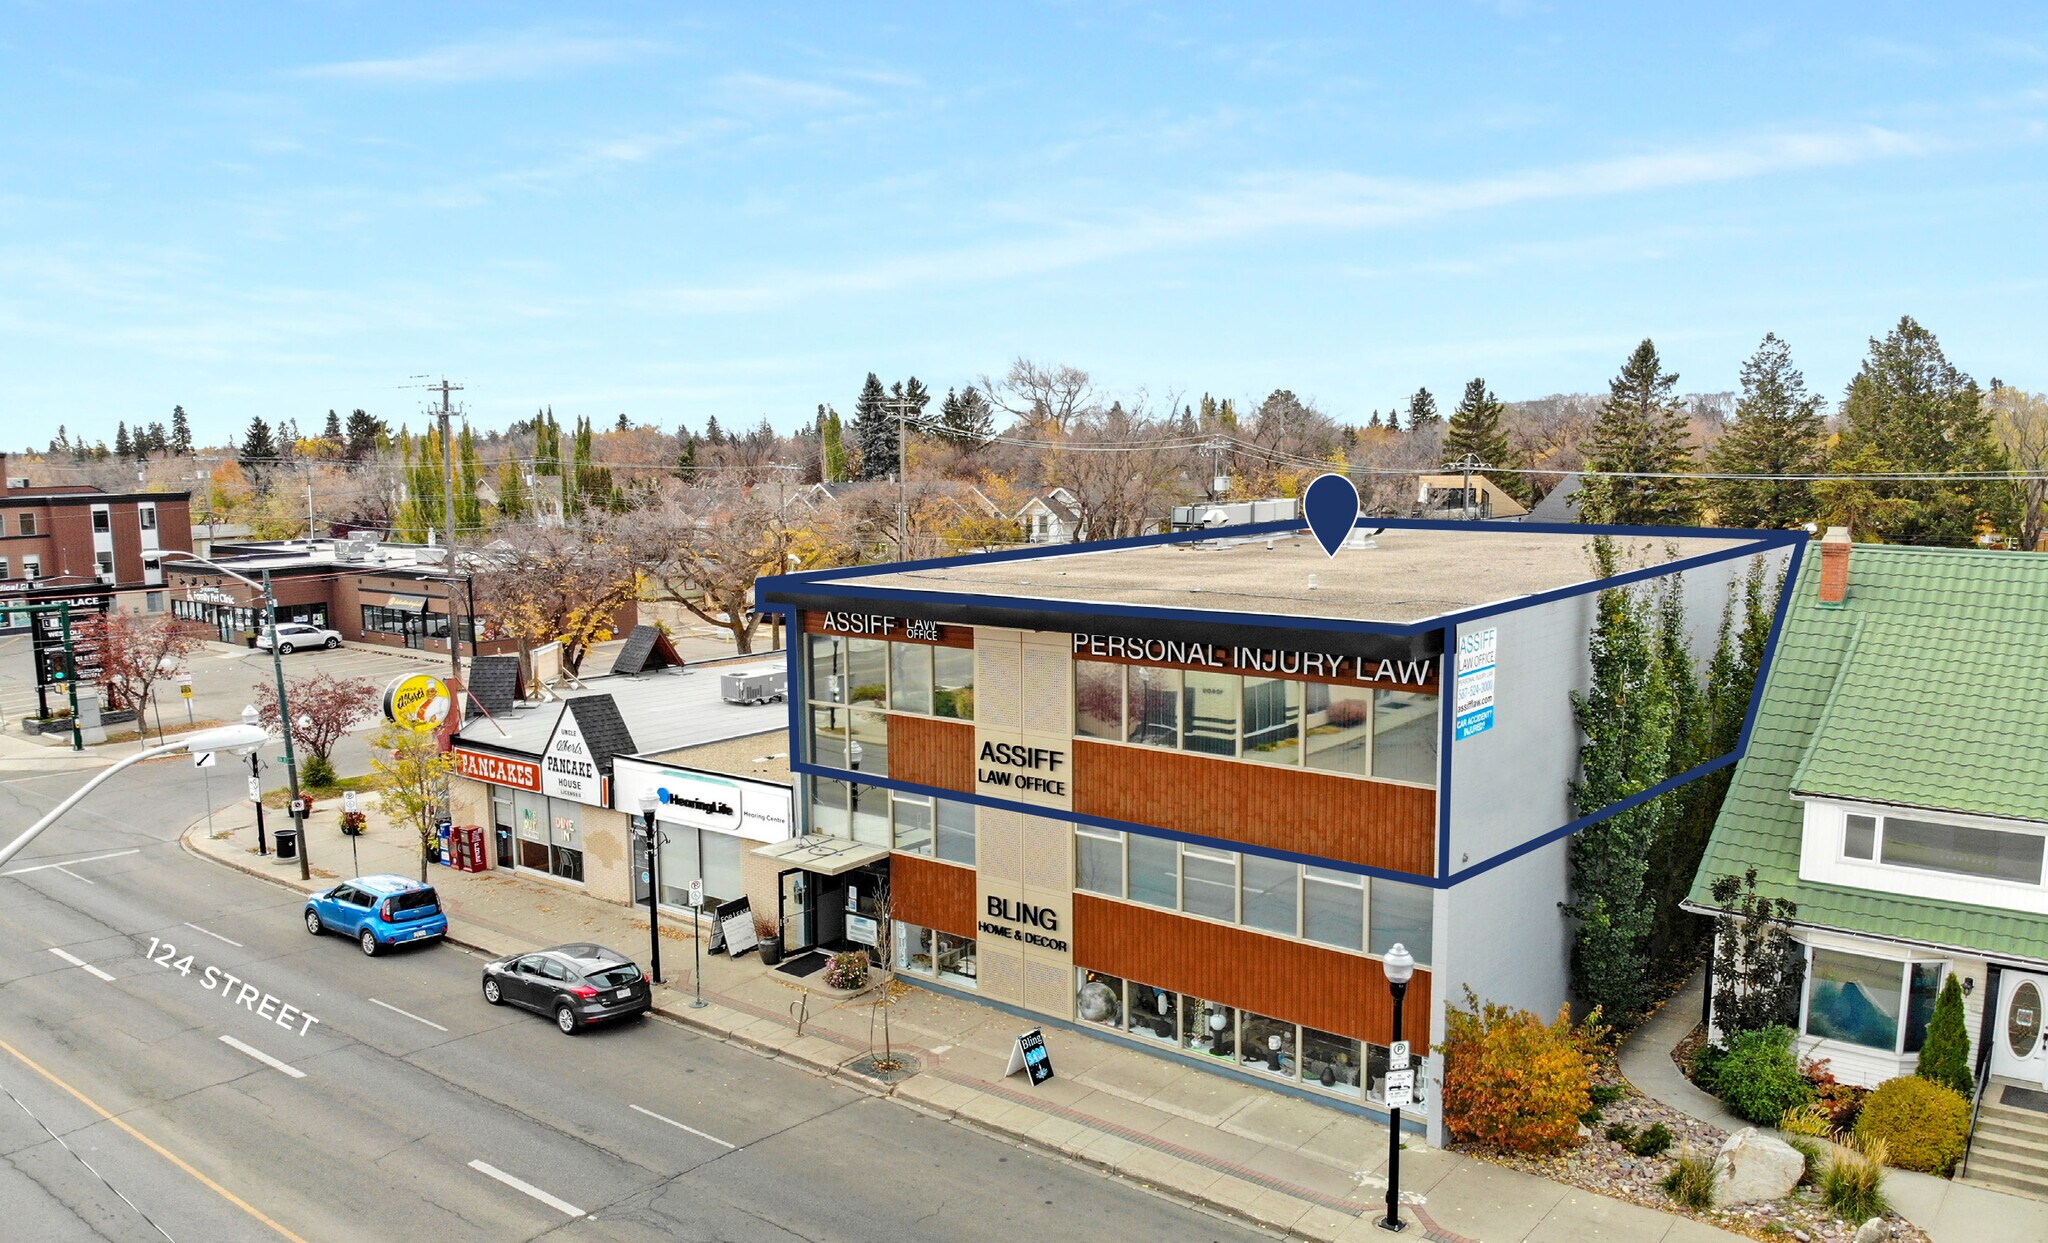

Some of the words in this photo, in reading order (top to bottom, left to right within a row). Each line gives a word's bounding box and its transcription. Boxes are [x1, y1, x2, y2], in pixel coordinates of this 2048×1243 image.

[823, 611, 895, 636] ASSIFF
[906, 618, 936, 631] LAW
[906, 629, 938, 641] OFFICE
[1460, 629, 1495, 655] ASSIFF
[1073, 633, 1223, 668] PERSONAL
[1233, 646, 1344, 678] INJURY
[1356, 656, 1430, 686] LAW
[1459, 655, 1474, 672] LAW
[1474, 650, 1495, 667] OFFICE
[561, 729, 577, 737] UNCLE
[547, 756, 593, 779] PANCAKE
[980, 741, 1064, 772] ASSIFF
[461, 753, 534, 787] PANCAKES
[558, 778, 582, 790] HOUSE
[978, 768, 1012, 787] LAW
[1014, 775, 1066, 796] OFFICE
[669, 793, 734, 816] HearingLife
[555, 817, 575, 832] DINE
[743, 811, 766, 822] Hearing
[766, 814, 786, 824] Centre
[987, 895, 1057, 931] BLING
[978, 921, 1012, 939] HOME
[1014, 930, 1022, 941] &
[1024, 932, 1068, 953] DECOR
[1021, 1034, 1043, 1050] Bling
